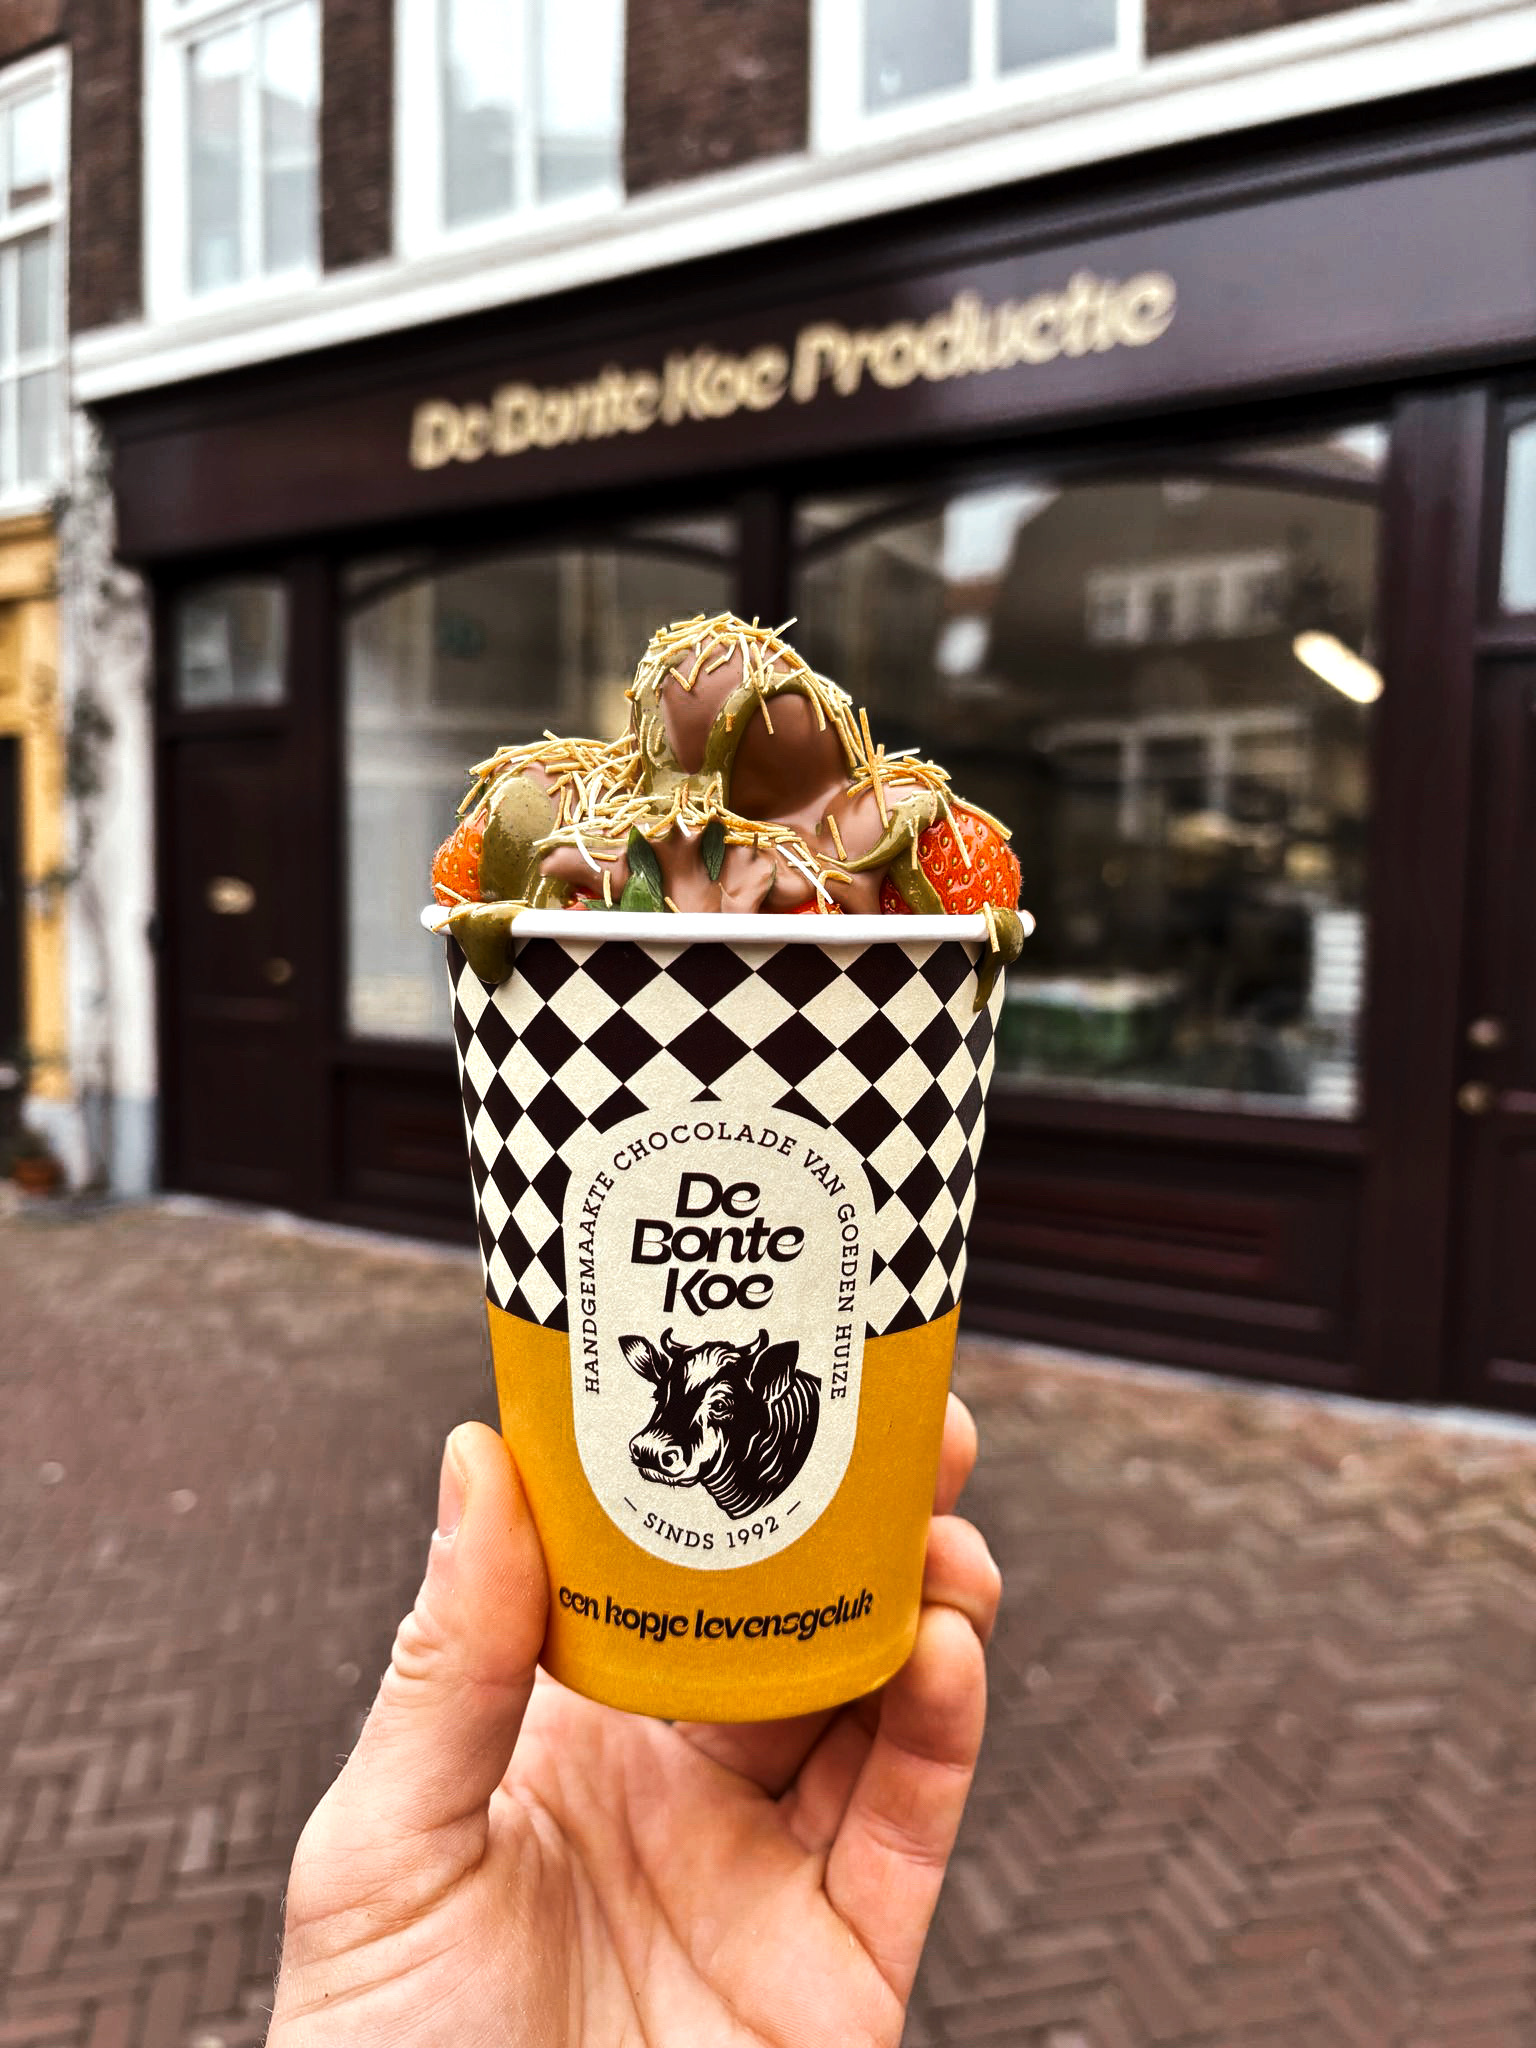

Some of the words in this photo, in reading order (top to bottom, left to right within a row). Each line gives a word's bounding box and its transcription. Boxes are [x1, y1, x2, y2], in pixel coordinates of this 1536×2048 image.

[409, 400, 491, 471] De
[661, 343, 789, 426] Koe
[791, 269, 1178, 404] Productie
[613, 1122, 797, 1171] CHOCOLADE
[675, 1172, 761, 1218] De
[802, 1149, 846, 1197] VAN
[631, 1217, 805, 1264] Bonte
[837, 1203, 859, 1312] GOEDEN
[578, 1171, 615, 1394] HANDGEMAAKTE
[663, 1267, 774, 1316] Koe
[831, 1323, 852, 1400] HUIZE
[643, 1512, 714, 1549] SINDS
[726, 1516, 779, 1548] 1992
[559, 1586, 600, 1620] een
[605, 1595, 689, 1642] kopje
[694, 1588, 873, 1640] levensgeluk
